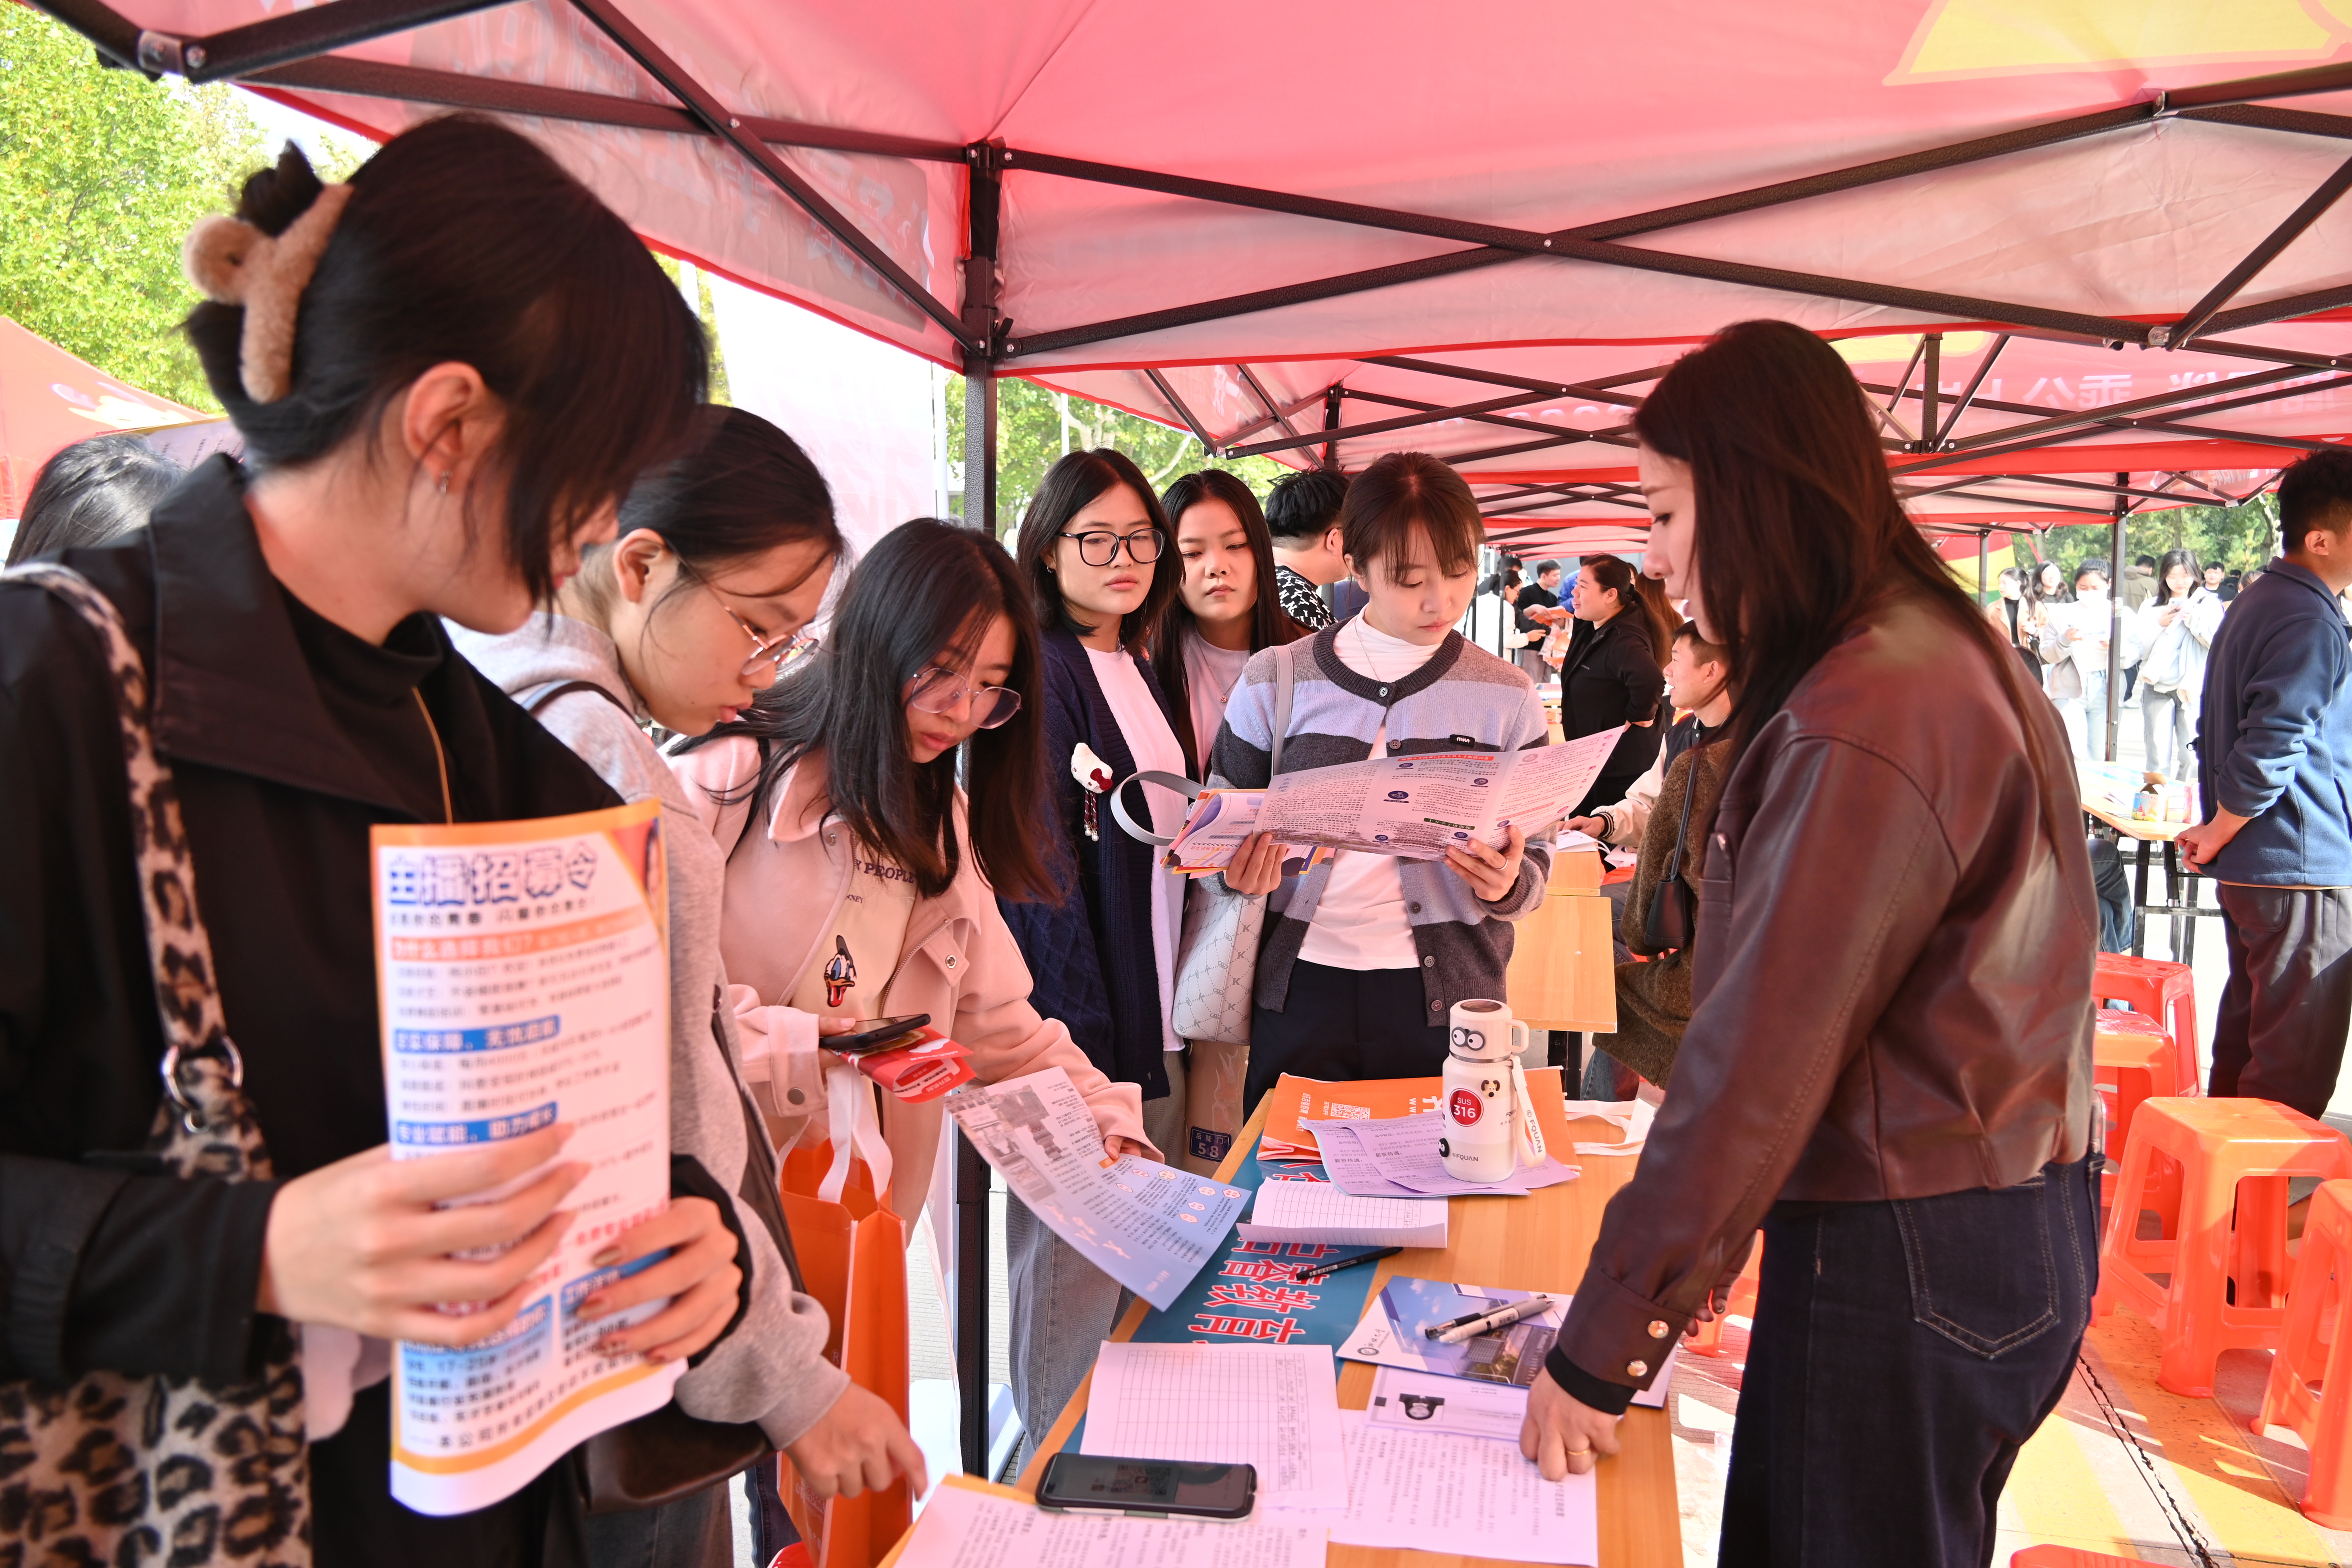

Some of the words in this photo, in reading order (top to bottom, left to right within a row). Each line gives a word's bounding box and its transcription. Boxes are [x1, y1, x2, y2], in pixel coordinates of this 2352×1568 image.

[864, 863, 915, 884] PEOPLE
[1457, 1097, 1471, 1105] SUS
[1454, 1105, 1476, 1118] 316
[1196, 1132, 1223, 1144] 后陡门
[1530, 1119, 1542, 1153] FQUAN
[1198, 1142, 1219, 1158] 58
